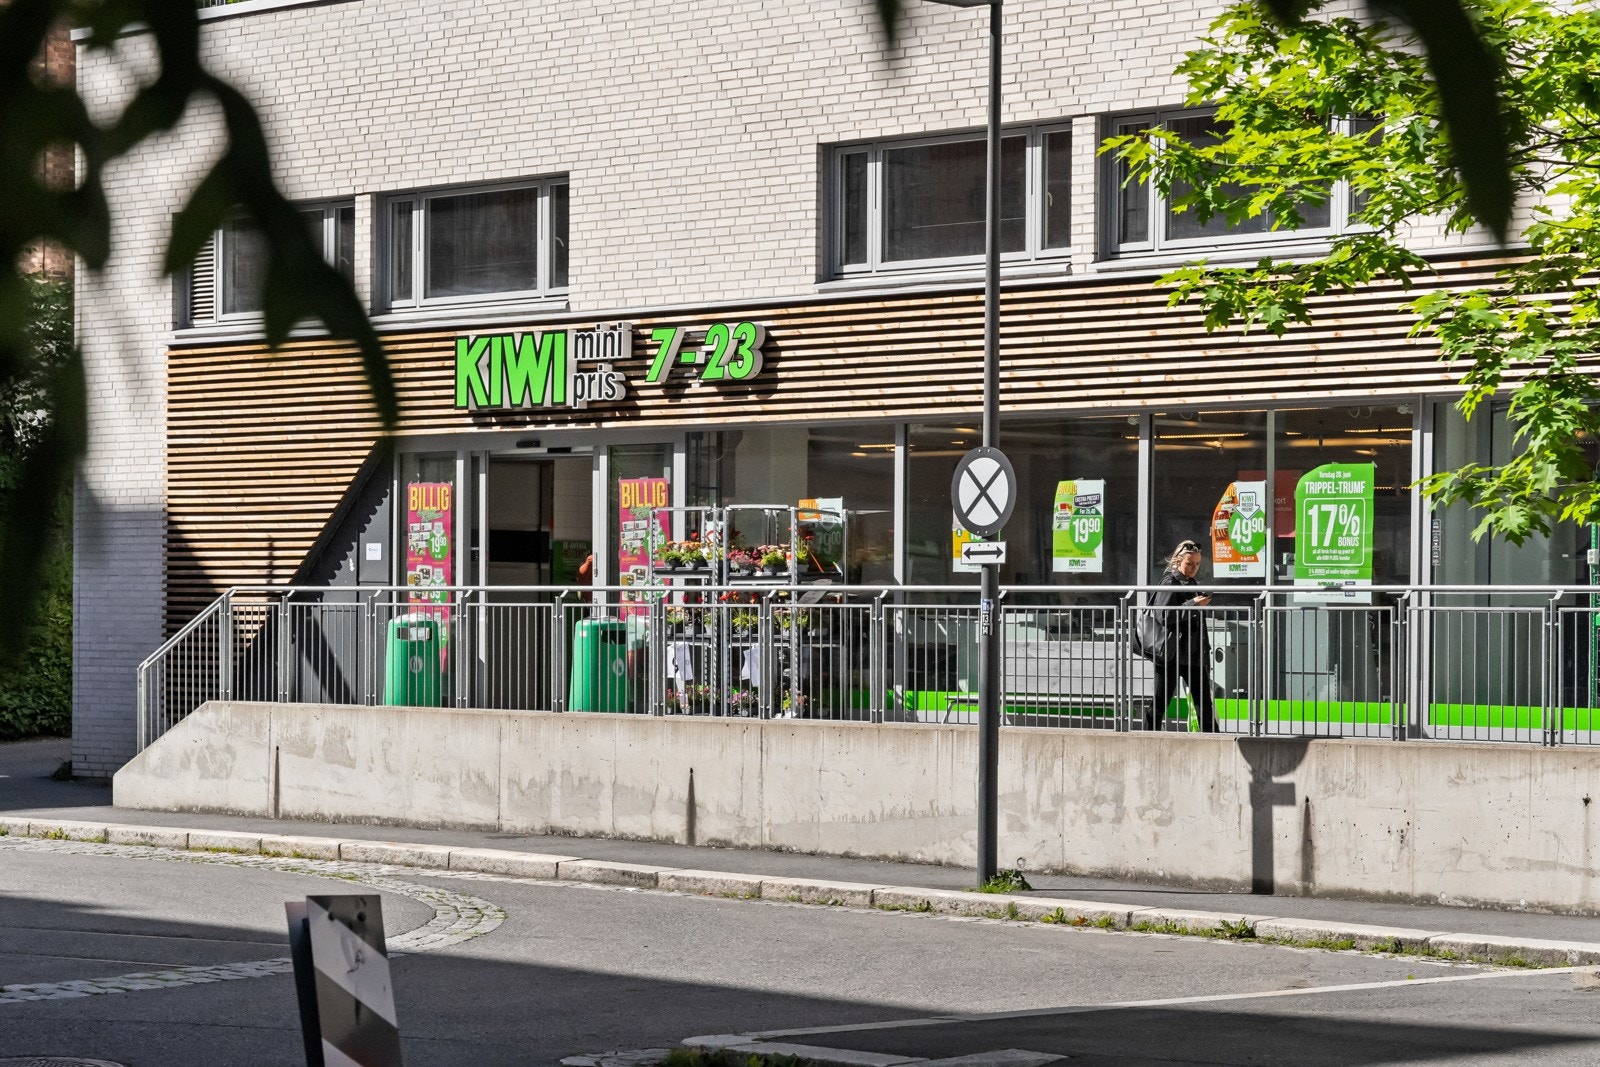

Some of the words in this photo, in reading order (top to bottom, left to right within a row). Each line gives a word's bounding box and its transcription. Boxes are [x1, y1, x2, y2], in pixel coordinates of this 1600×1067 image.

[573, 322, 625, 361] mini
[454, 329, 568, 410] KIWI
[572, 363, 617, 410] pris
[1304, 481, 1366, 495] TRIPPEL-TRUMF
[1342, 471, 1352, 479] juni
[409, 486, 450, 511] BILLIG
[621, 481, 667, 509] BILLIG
[1308, 504, 1360, 547] 17%
[1337, 536, 1359, 547] BONUS
